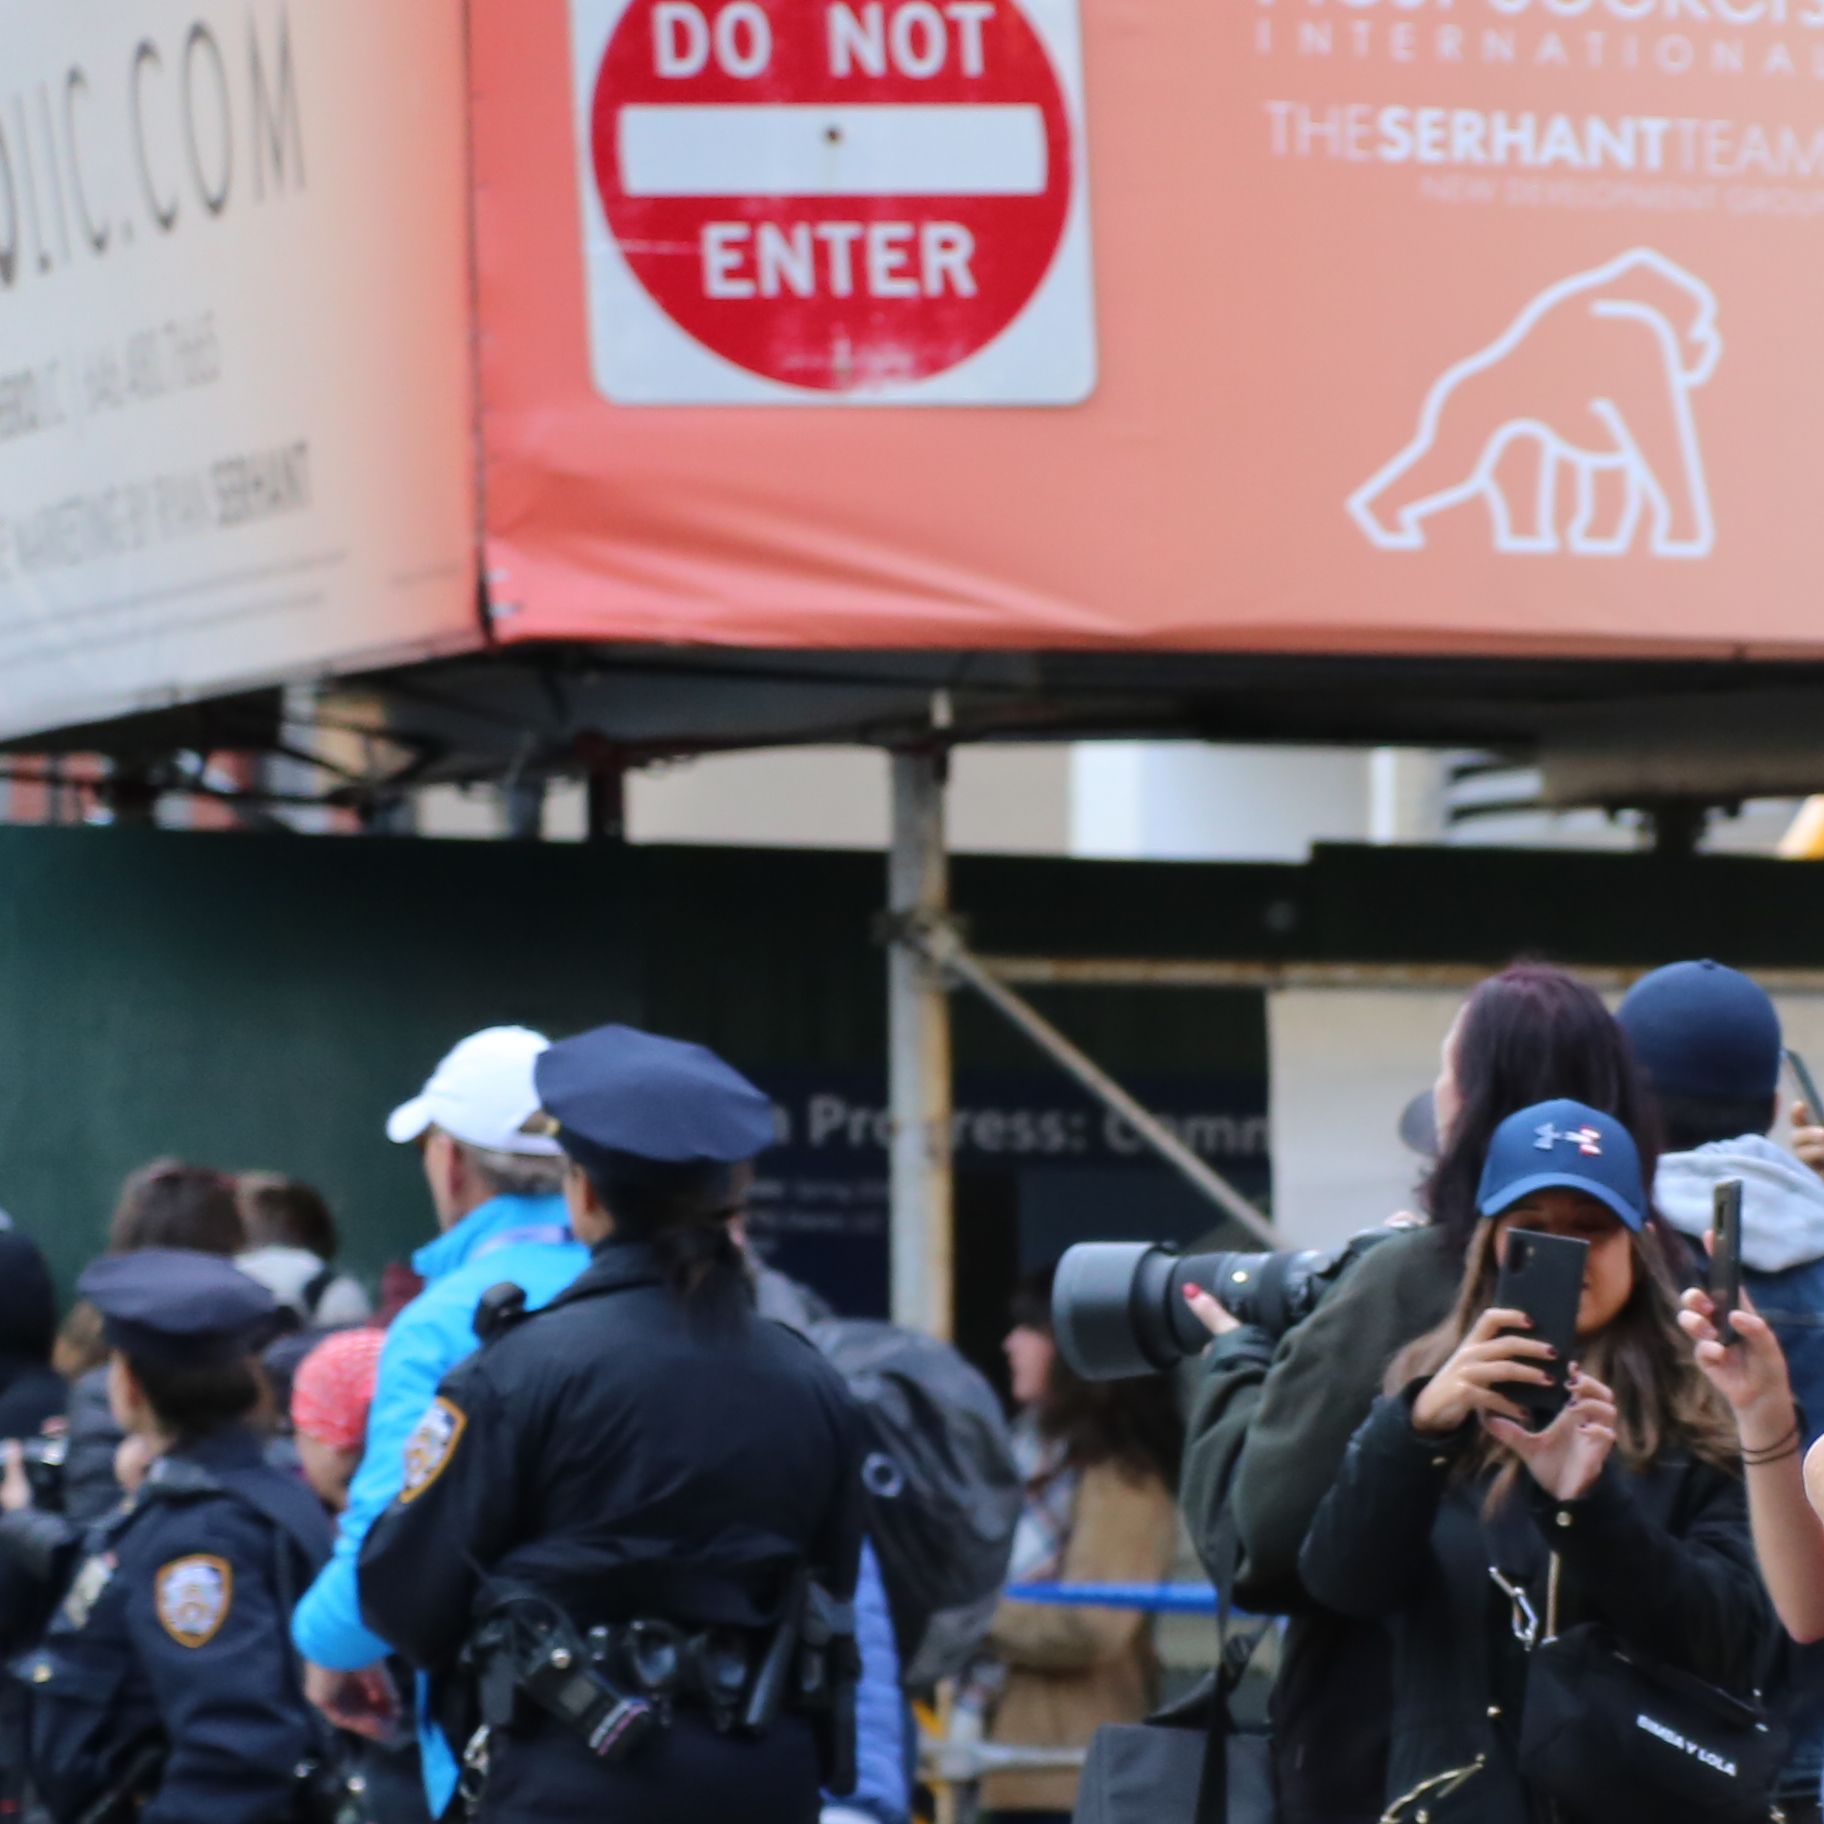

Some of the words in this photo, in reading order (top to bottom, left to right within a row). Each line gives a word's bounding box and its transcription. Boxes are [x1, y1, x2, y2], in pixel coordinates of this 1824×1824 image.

[652, 2, 773, 79] DO
[826, 1, 994, 79] NOT
[700, 220, 977, 300] ENTER
[808, 1092, 1087, 1154] Proress:
[1697, 1748, 1738, 1777] LOLA
